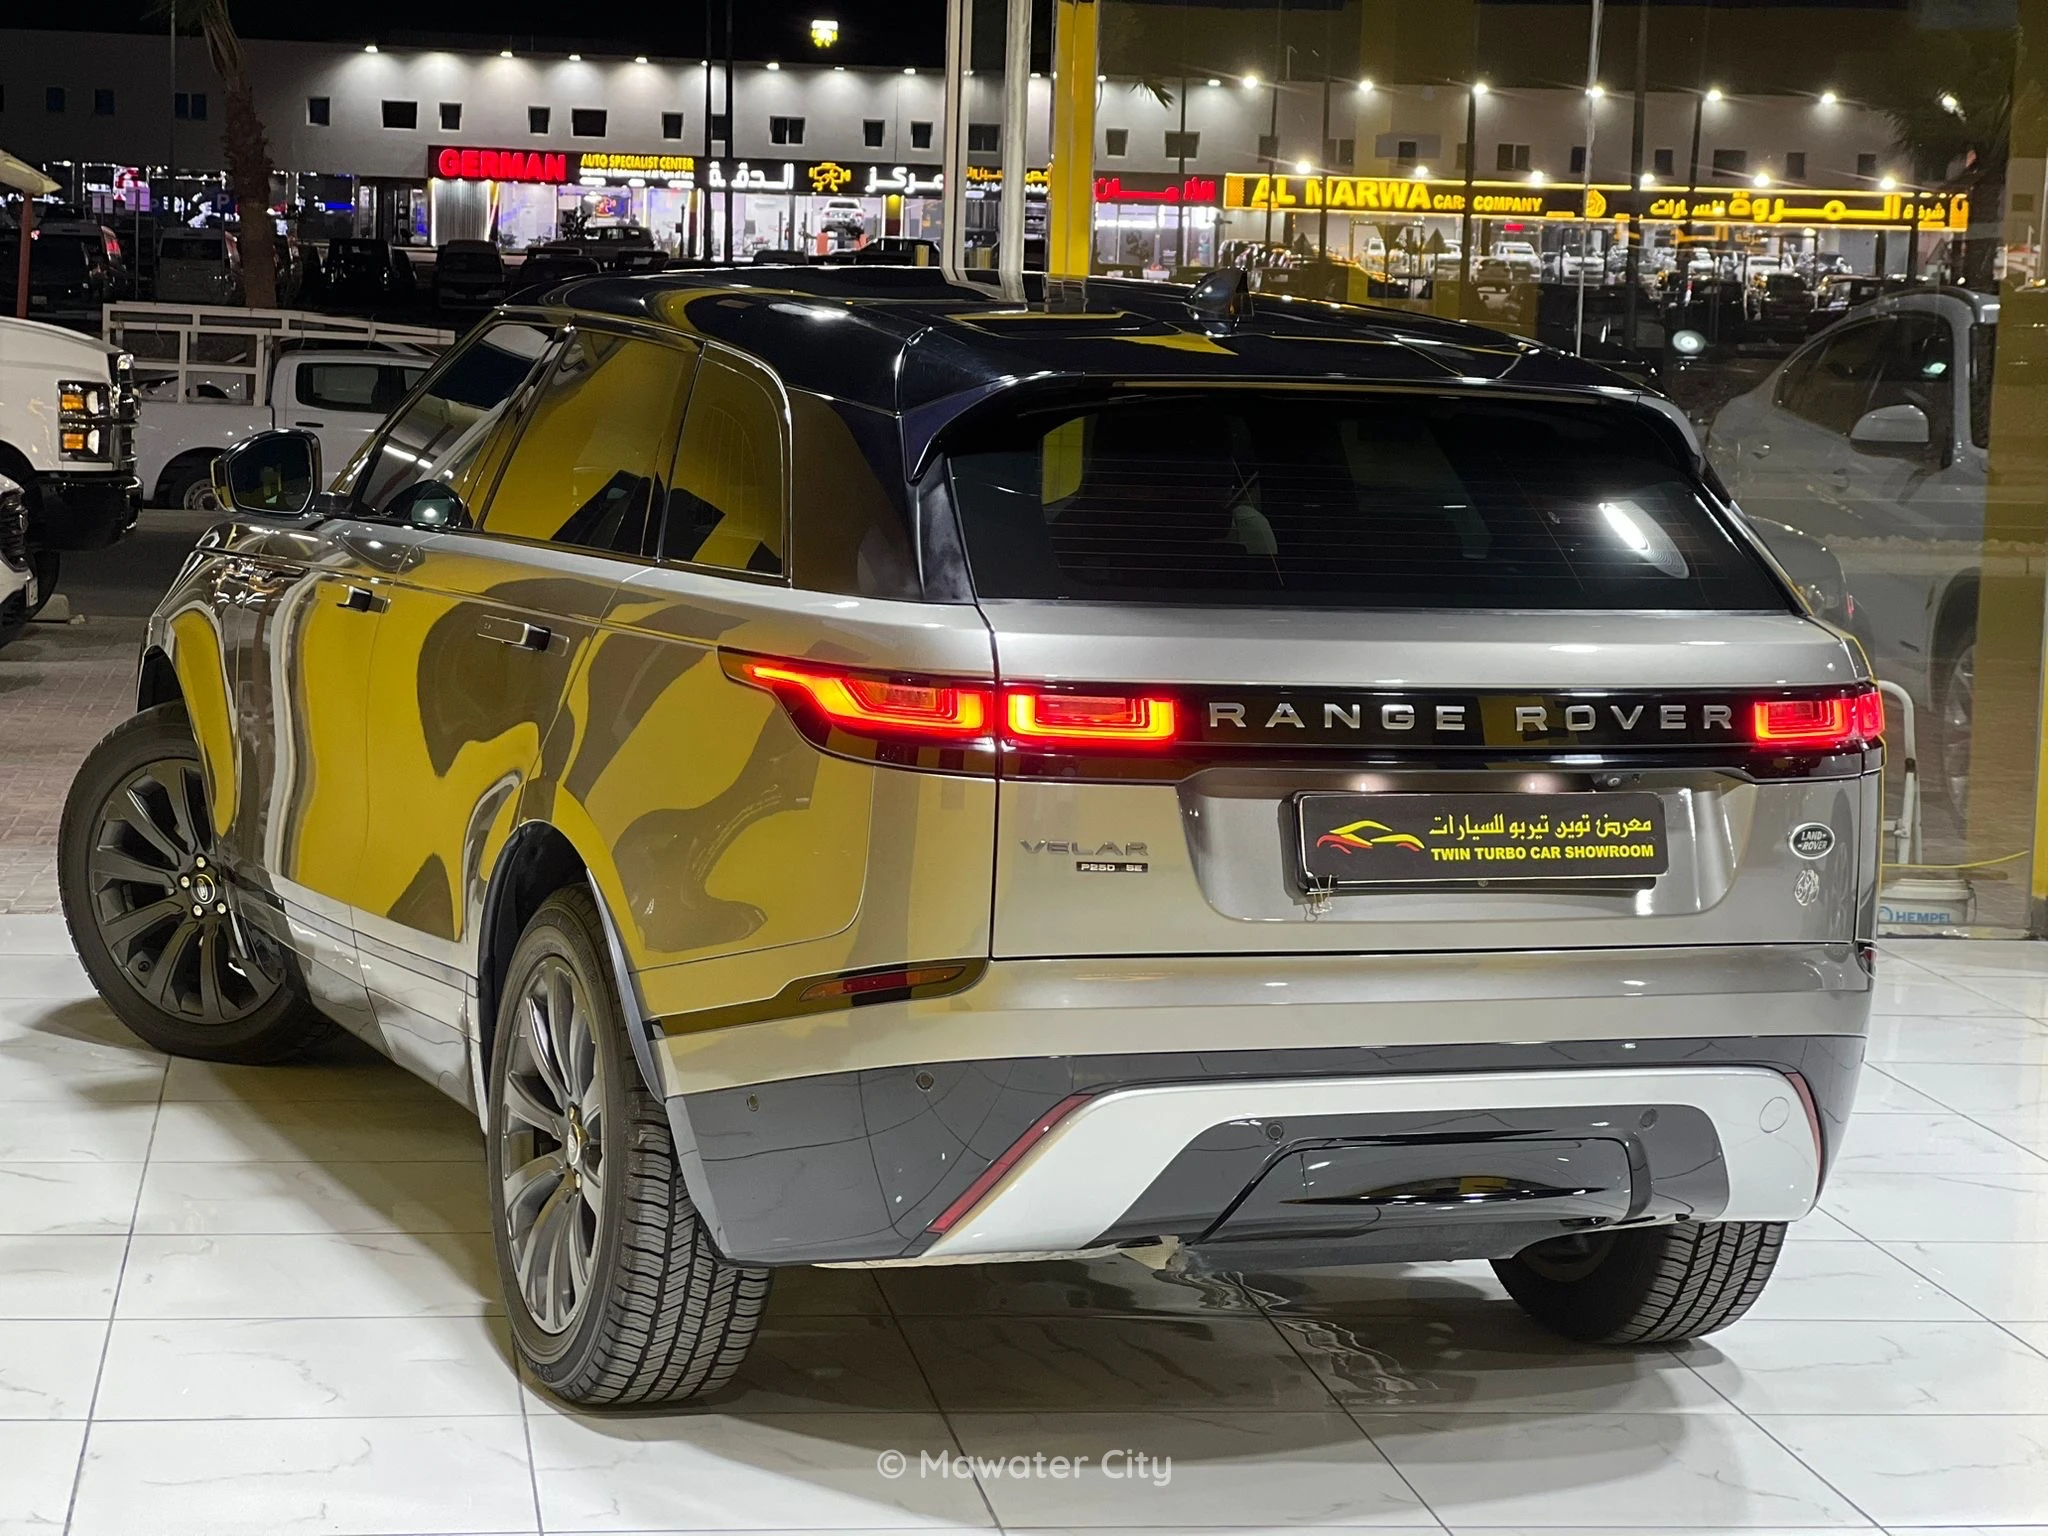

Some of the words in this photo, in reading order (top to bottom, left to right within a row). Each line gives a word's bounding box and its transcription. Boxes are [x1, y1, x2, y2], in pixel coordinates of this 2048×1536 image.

[438, 148, 566, 181] GERMAN
[581, 153, 608, 167] AUTO
[609, 155, 659, 170] SPECIALIST
[660, 157, 694, 171] CENTER
[1252, 177, 1296, 205] AL
[1305, 178, 1431, 209] MARWA
[1473, 195, 1543, 212] COMPANY
[1209, 702, 1466, 731] RANGE
[1516, 704, 1733, 732] ROVER
[1429, 813, 1505, 840] للسيارات
[1509, 814, 1550, 840] تيربو
[1555, 814, 1591, 838] توين
[1596, 813, 1652, 838] معرض
[1019, 839, 1149, 856] VELAR
[1431, 847, 1471, 860] TWIN
[1474, 846, 1527, 860] TURBO
[1530, 845, 1561, 860] CAR
[1565, 844, 1654, 859] SHOWROOM
[1081, 863, 1116, 872] P250
[1126, 864, 1143, 872] SE
